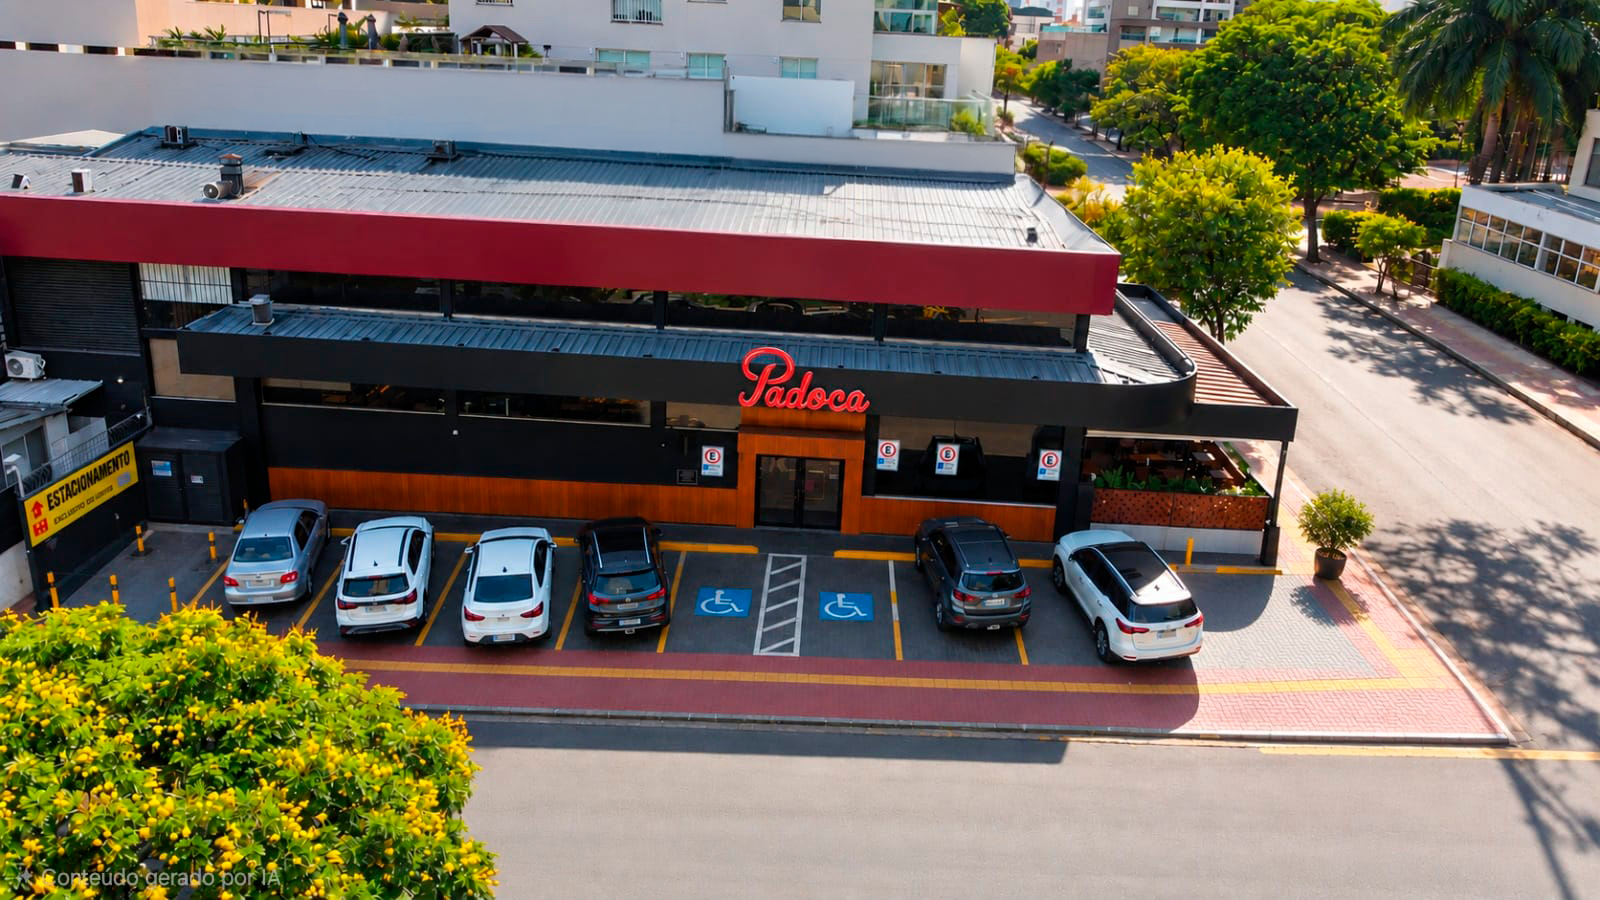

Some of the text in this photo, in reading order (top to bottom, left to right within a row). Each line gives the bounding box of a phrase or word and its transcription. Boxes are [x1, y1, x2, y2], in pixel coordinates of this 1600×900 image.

[738, 346, 870, 413] Padoca
[885, 445, 892, 455] E
[944, 449, 951, 459] E
[1046, 455, 1054, 465] E
[46, 449, 131, 511] ESTACIONAMENTO
